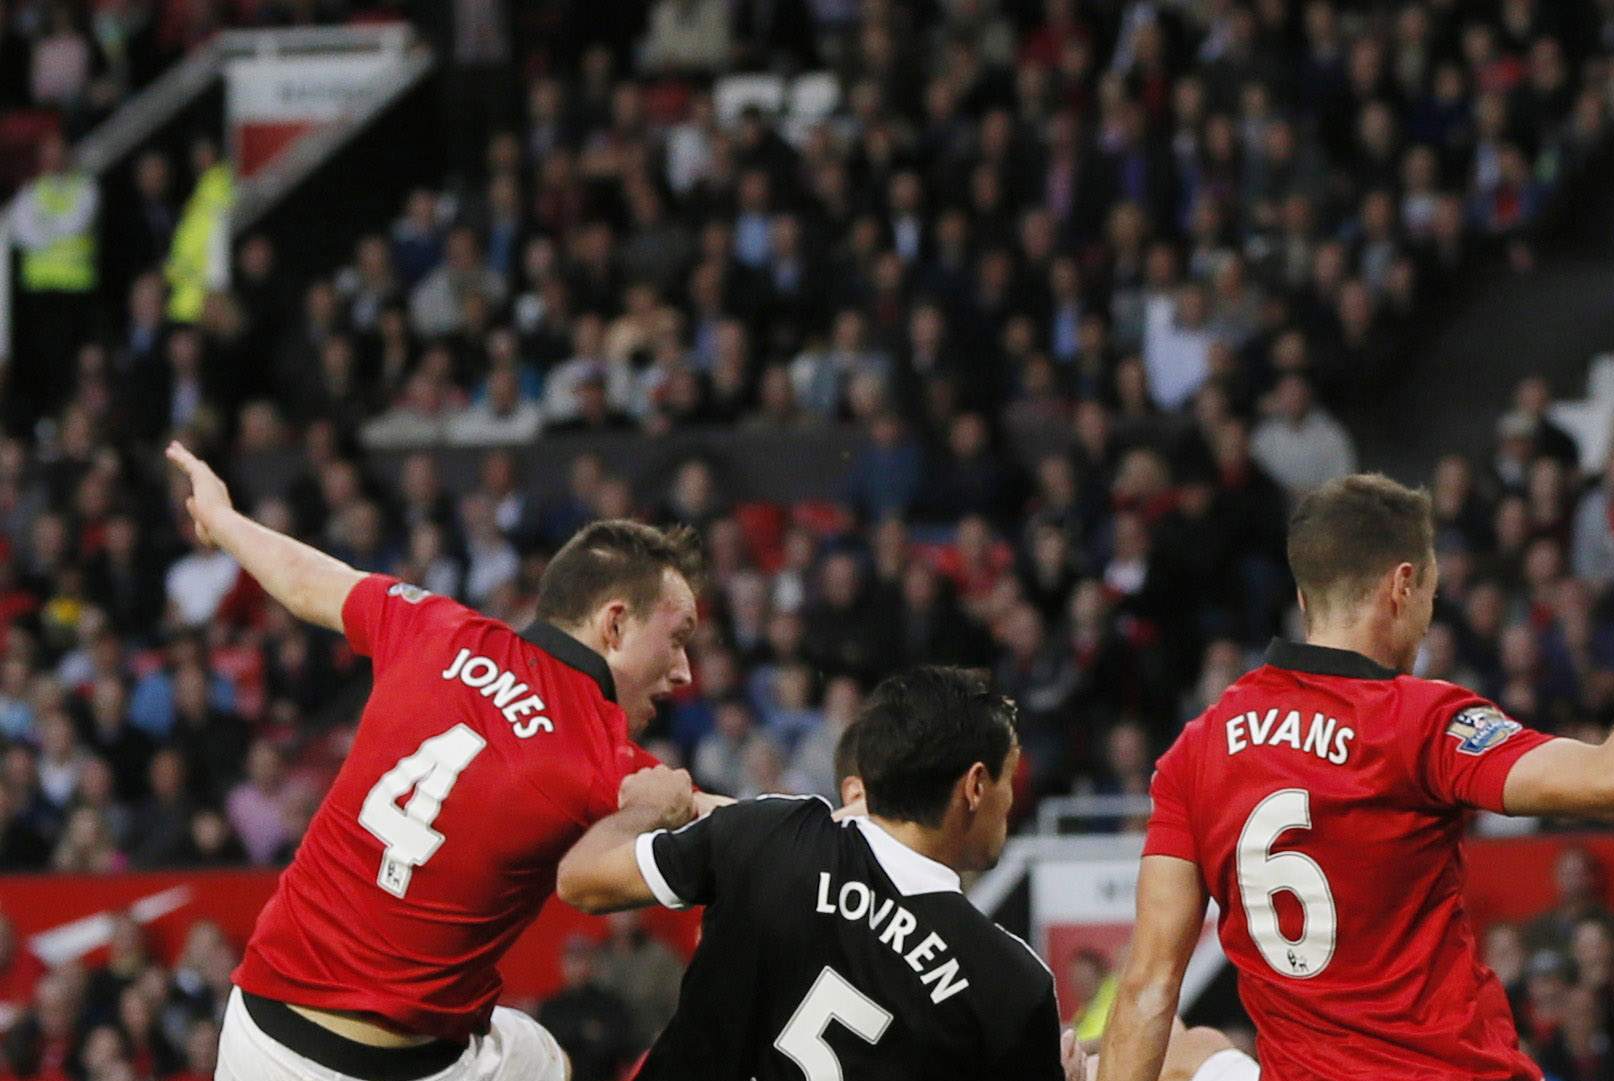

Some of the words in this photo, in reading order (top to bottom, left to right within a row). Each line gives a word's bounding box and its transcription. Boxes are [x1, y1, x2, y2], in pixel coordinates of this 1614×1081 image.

[442, 648, 554, 739] JONES
[1225, 707, 1355, 766] EVANS
[357, 722, 488, 900] 4
[816, 871, 970, 1005] LOVREN
[1236, 787, 1338, 980] 6
